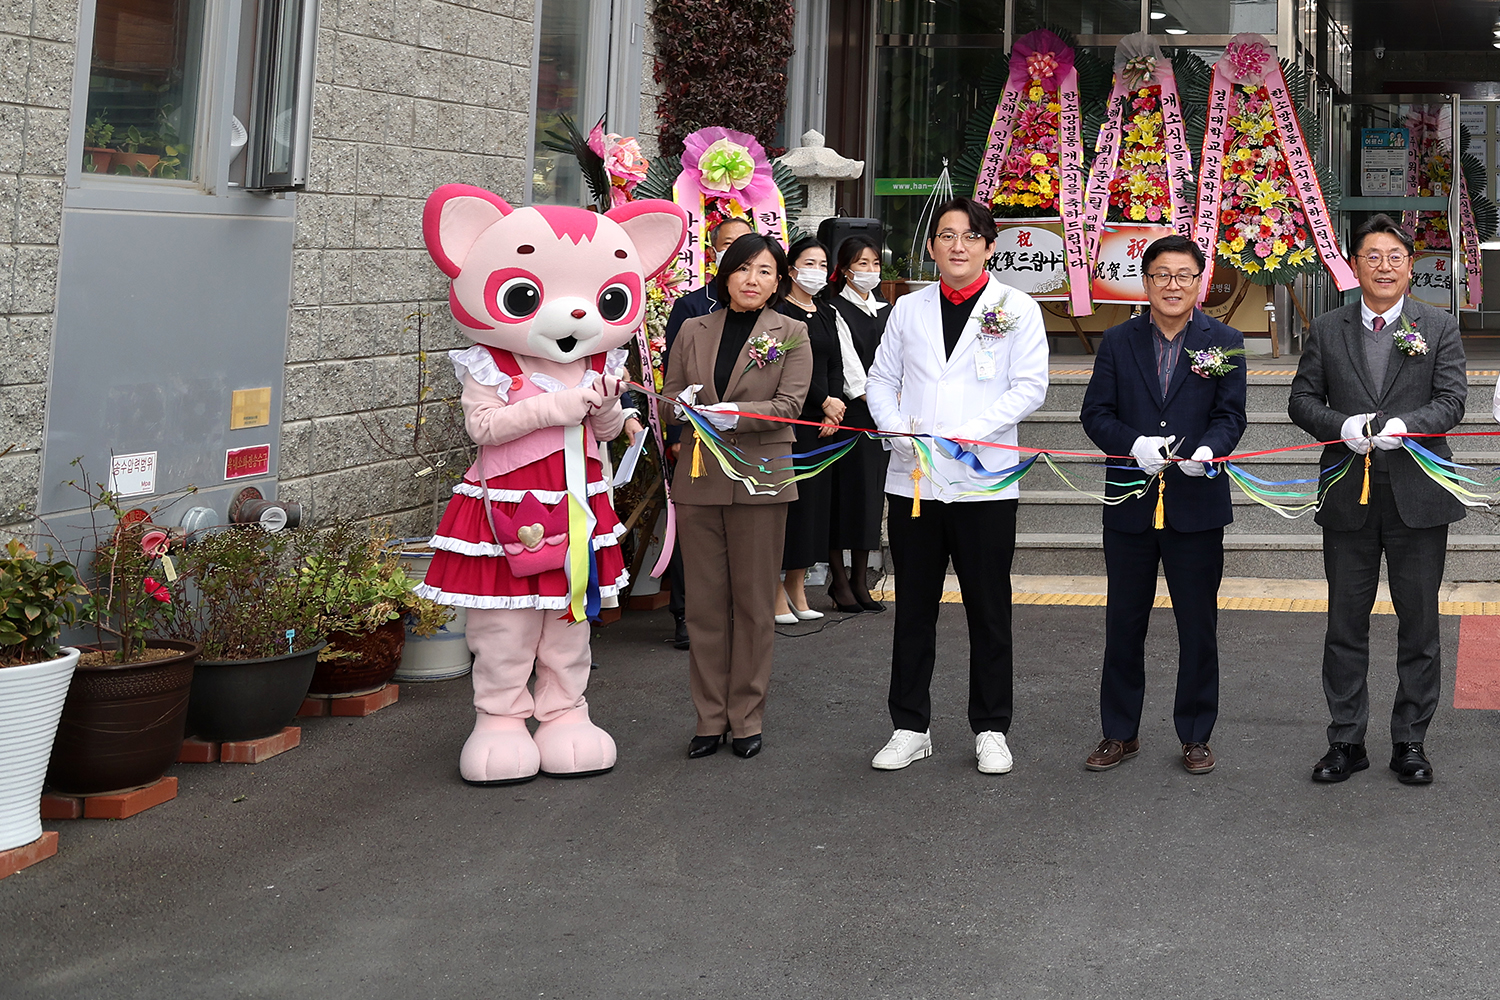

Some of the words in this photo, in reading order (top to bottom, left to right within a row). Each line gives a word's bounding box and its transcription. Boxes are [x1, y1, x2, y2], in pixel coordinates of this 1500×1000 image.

[995, 90, 1018, 126] 김해시
[1163, 92, 1186, 161] 개소식을
[1206, 89, 1227, 153] 경주대학교
[1062, 151, 1081, 195] 개소식을
[1200, 156, 1219, 206] 간호학과
[1199, 209, 1215, 233] 교수
[1289, 146, 1316, 193] 개소식을
[1304, 195, 1339, 261] 축하드립니다
[1016, 230, 1033, 248] 祝
[1063, 197, 1089, 269] 축하드립니다
[1465, 220, 1481, 276] 축하드립니다
[1434, 258, 1447, 272] 祝
[113, 456, 154, 476] 송수압력범위
